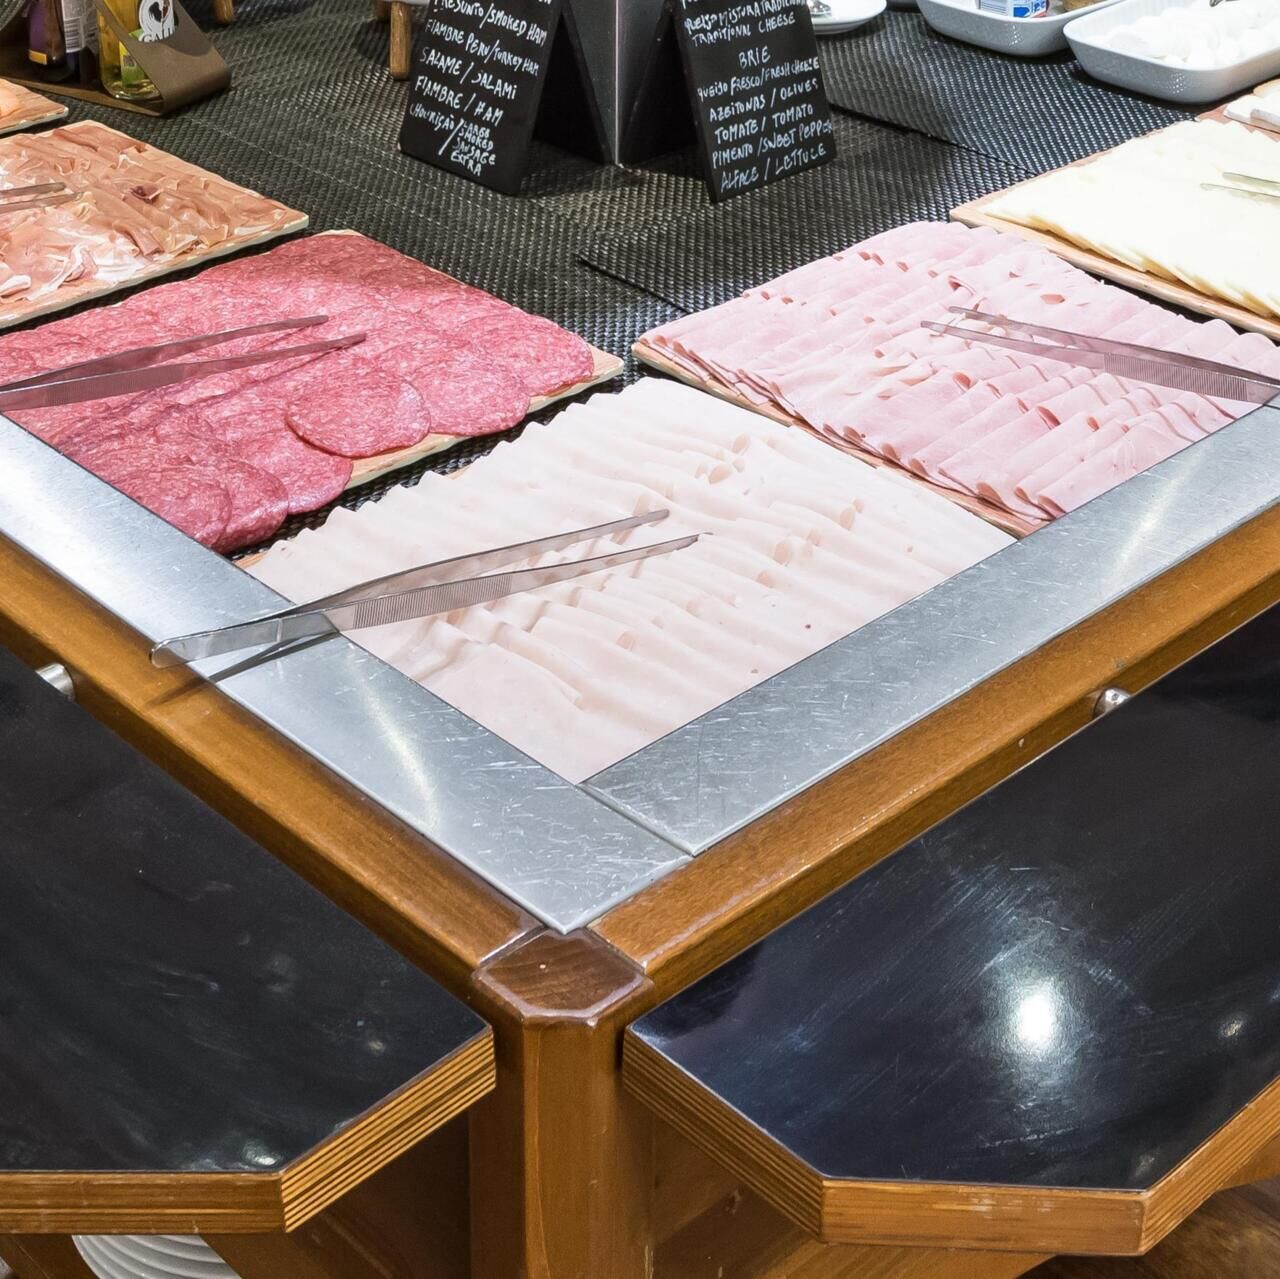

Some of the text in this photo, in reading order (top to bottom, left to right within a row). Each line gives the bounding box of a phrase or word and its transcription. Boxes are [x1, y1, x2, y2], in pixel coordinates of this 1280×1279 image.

[526, 23, 548, 47] HAM
[758, 11, 796, 33] CHEESE
[420, 46, 462, 75] SALAME
[425, 19, 465, 44] FIAMBRE
[521, 57, 540, 77] HAM
[738, 46, 771, 69] BRIE
[414, 75, 463, 109] FIAMBRE
[474, 101, 504, 127] HAM
[780, 78, 819, 101] OLIVES
[714, 119, 759, 145] TOMATE
[772, 103, 814, 128] TOMATO
[450, 150, 482, 176] EXTRA
[712, 143, 754, 169] PIMENTO
[720, 166, 760, 193] ALFACE
